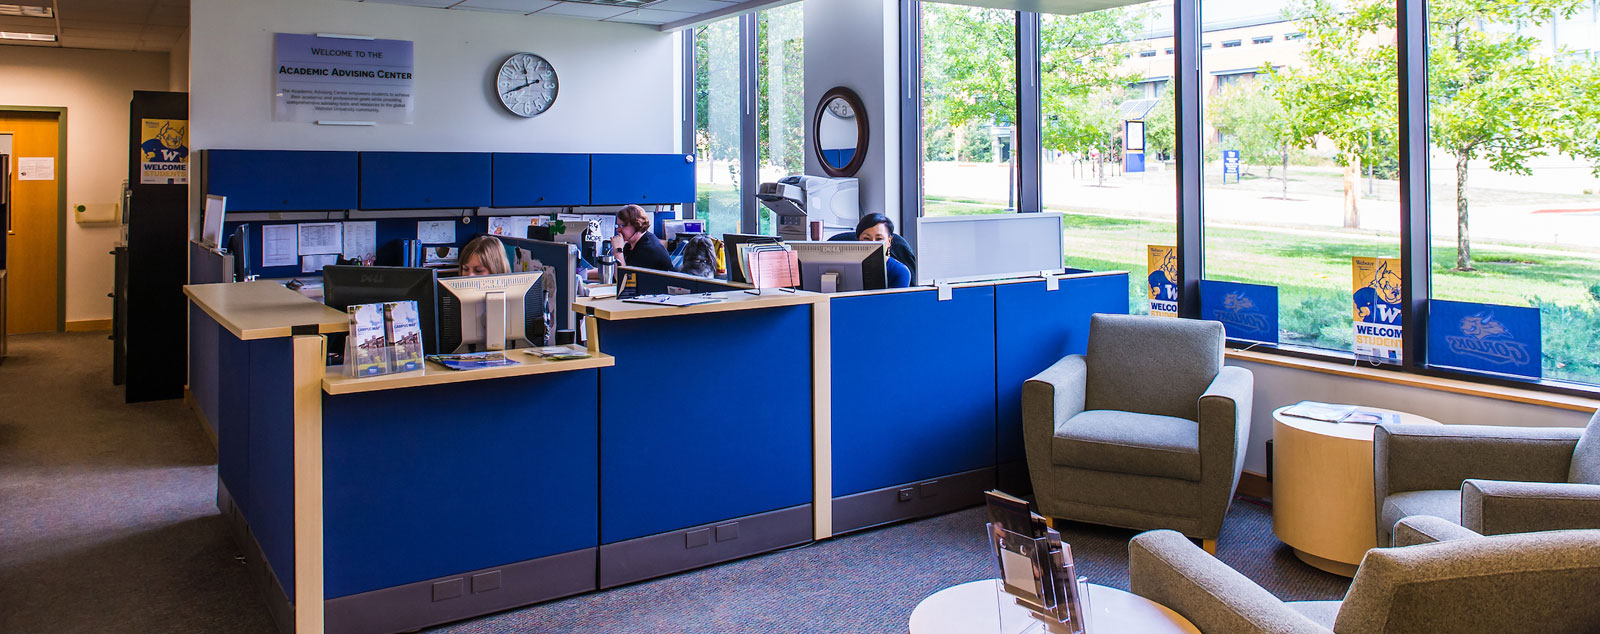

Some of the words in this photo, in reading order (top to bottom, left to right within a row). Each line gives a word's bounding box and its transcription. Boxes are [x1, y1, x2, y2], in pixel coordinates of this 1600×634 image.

[311, 47, 353, 57] WELCOME
[355, 50, 365, 58] TO
[279, 65, 329, 76] ACADEMIC
[331, 67, 375, 78] ADVISING
[377, 69, 412, 79] CENTER
[161, 150, 179, 161] W
[361, 274, 384, 283] DELL
[1377, 304, 1401, 323] W
